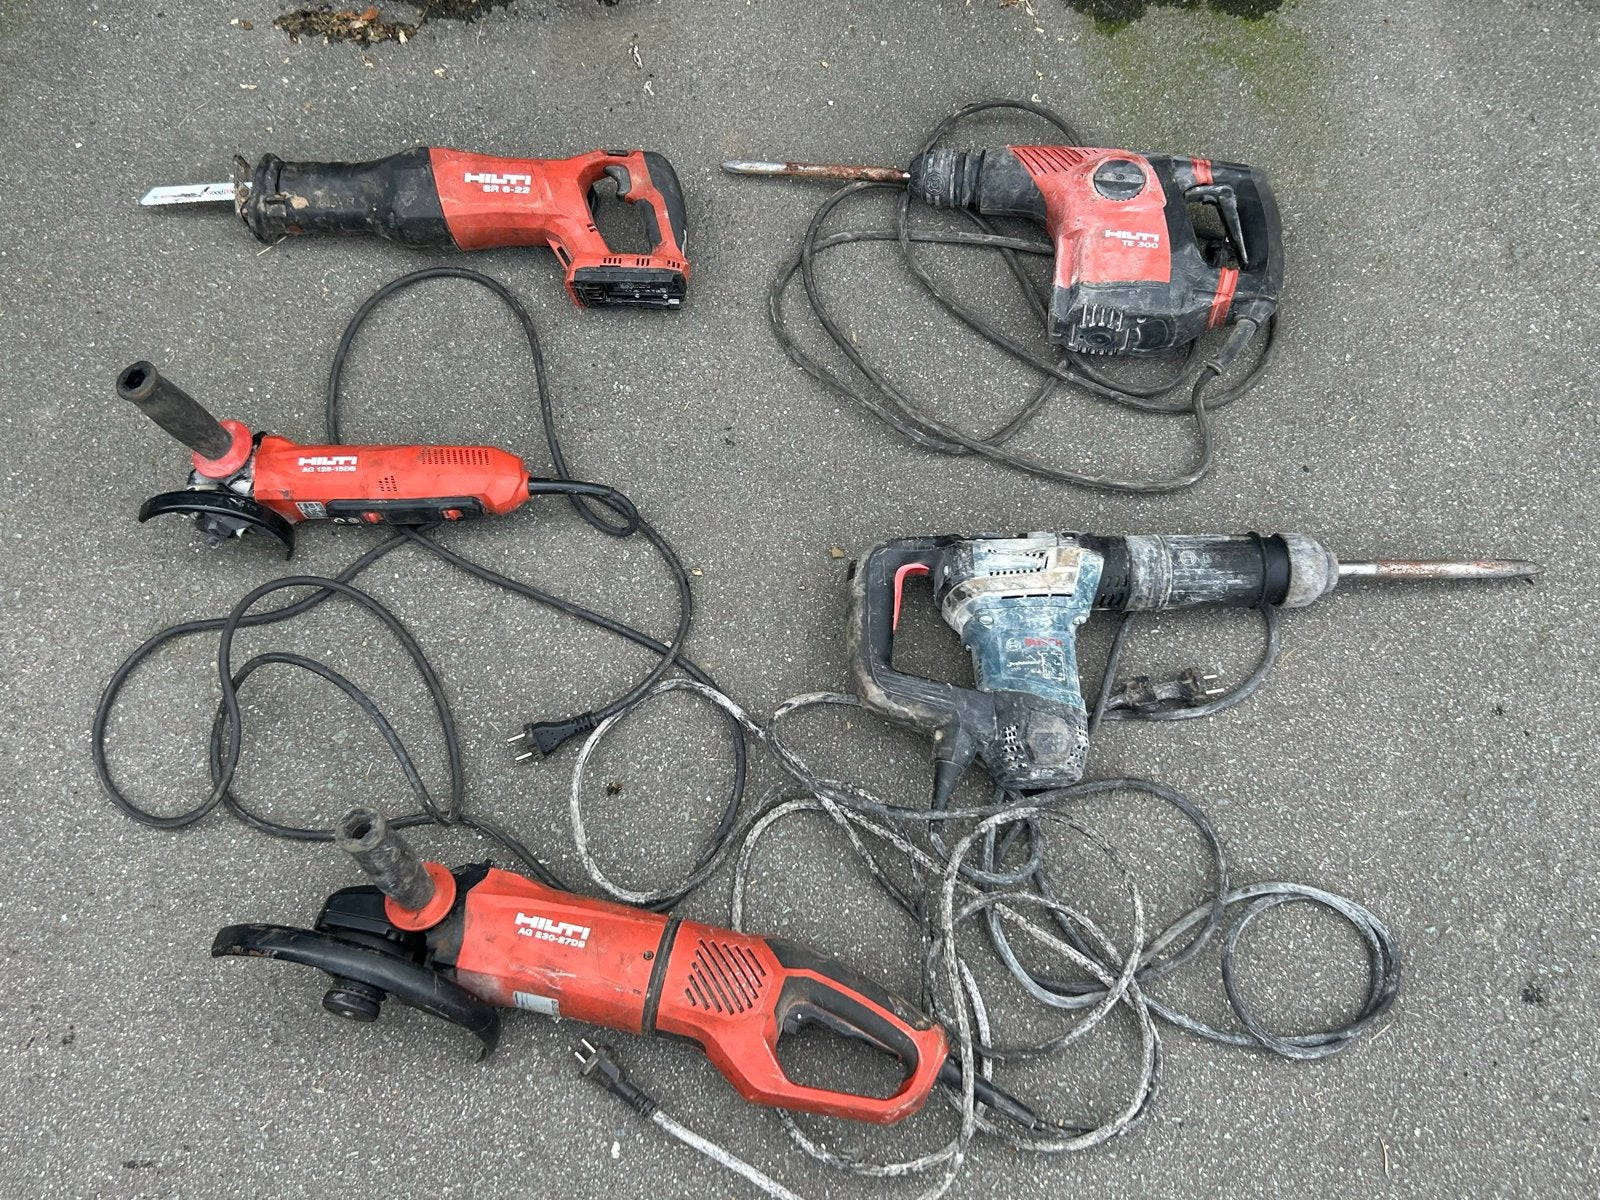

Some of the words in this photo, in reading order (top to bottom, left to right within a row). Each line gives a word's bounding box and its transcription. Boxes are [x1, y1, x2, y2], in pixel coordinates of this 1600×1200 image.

[464, 172, 531, 185] HILTI
[482, 185, 500, 193] SR
[502, 186, 531, 194] 6-22
[1104, 229, 1160, 242] HILTI
[1121, 239, 1136, 247] TE
[1136, 241, 1159, 249] 300
[298, 456, 358, 466] HILTI
[514, 912, 591, 940] HILTI
[517, 927, 533, 937] AG
